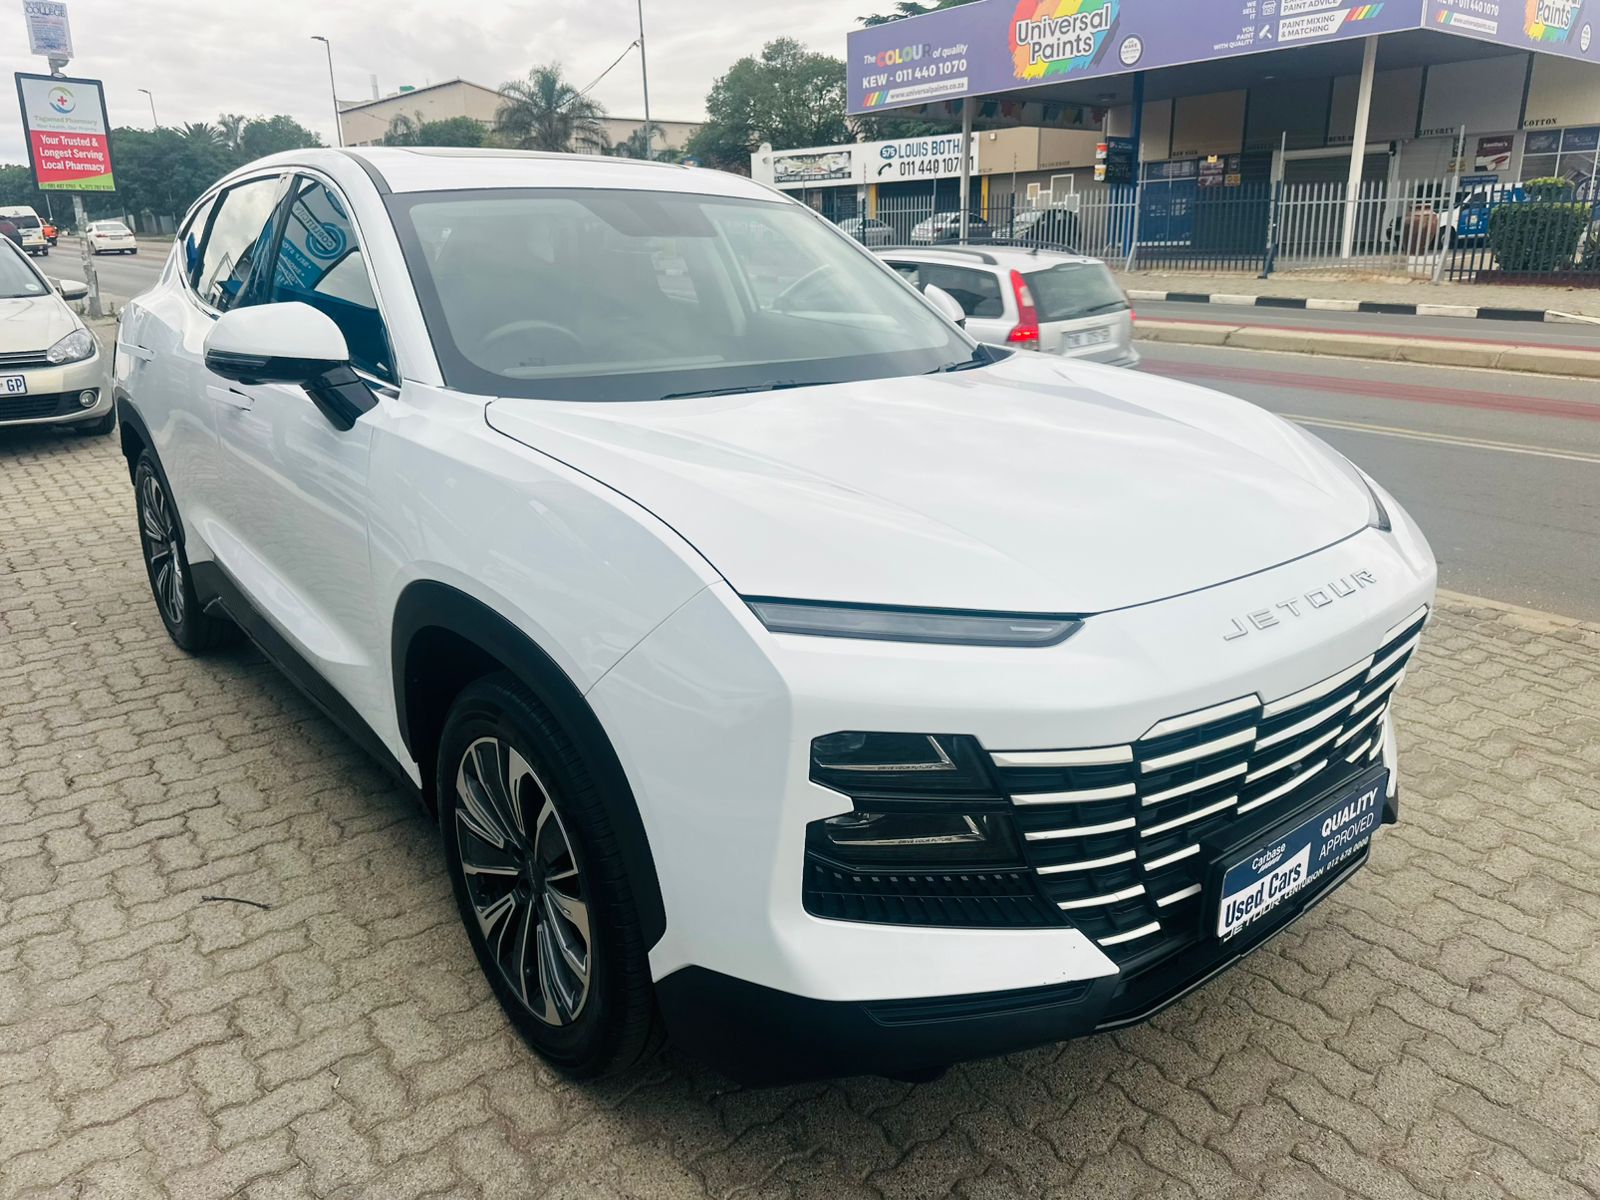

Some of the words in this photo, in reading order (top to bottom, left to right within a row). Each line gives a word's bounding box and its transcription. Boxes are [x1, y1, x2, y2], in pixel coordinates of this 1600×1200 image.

[1283, 4, 1307, 12] PAINT
[1536, 0, 1571, 28] Paints
[1017, 4, 1110, 44] Universal
[1282, 20, 1305, 30] PAINT
[1306, 14, 1336, 24] MIXING
[1287, 24, 1329, 37] MATCHING
[864, 54, 876, 64] The
[876, 43, 932, 68] COLOUR
[932, 48, 942, 58] of
[942, 43, 968, 58] quality
[1030, 33, 1093, 62] Paints
[862, 73, 888, 88] KEW
[896, 68, 912, 82] 011
[914, 64, 937, 80] 440
[938, 59, 968, 75] 1070
[1524, 118, 1558, 127] COTTON
[40, 134, 59, 144] Your
[60, 135, 90, 146] Trusted
[92, 138, 98, 147] &
[898, 142, 928, 159] LOUIS
[40, 147, 72, 159] Longest
[73, 149, 104, 161] Serving
[42, 160, 64, 170] Local
[66, 160, 105, 174] Pharmacy
[900, 160, 916, 176] 011
[918, 159, 940, 174] 440
[6, 378, 23, 392] GP
[1223, 568, 1378, 642] JETOUR
[1321, 786, 1379, 838] QUALITY
[1318, 812, 1374, 861] APPROVED
[1252, 843, 1286, 870] Carbase
[1284, 866, 1324, 900] CENTURION
[1326, 856, 1340, 870] 012
[1225, 881, 1265, 928] Used
[1268, 862, 1303, 900] Cars
